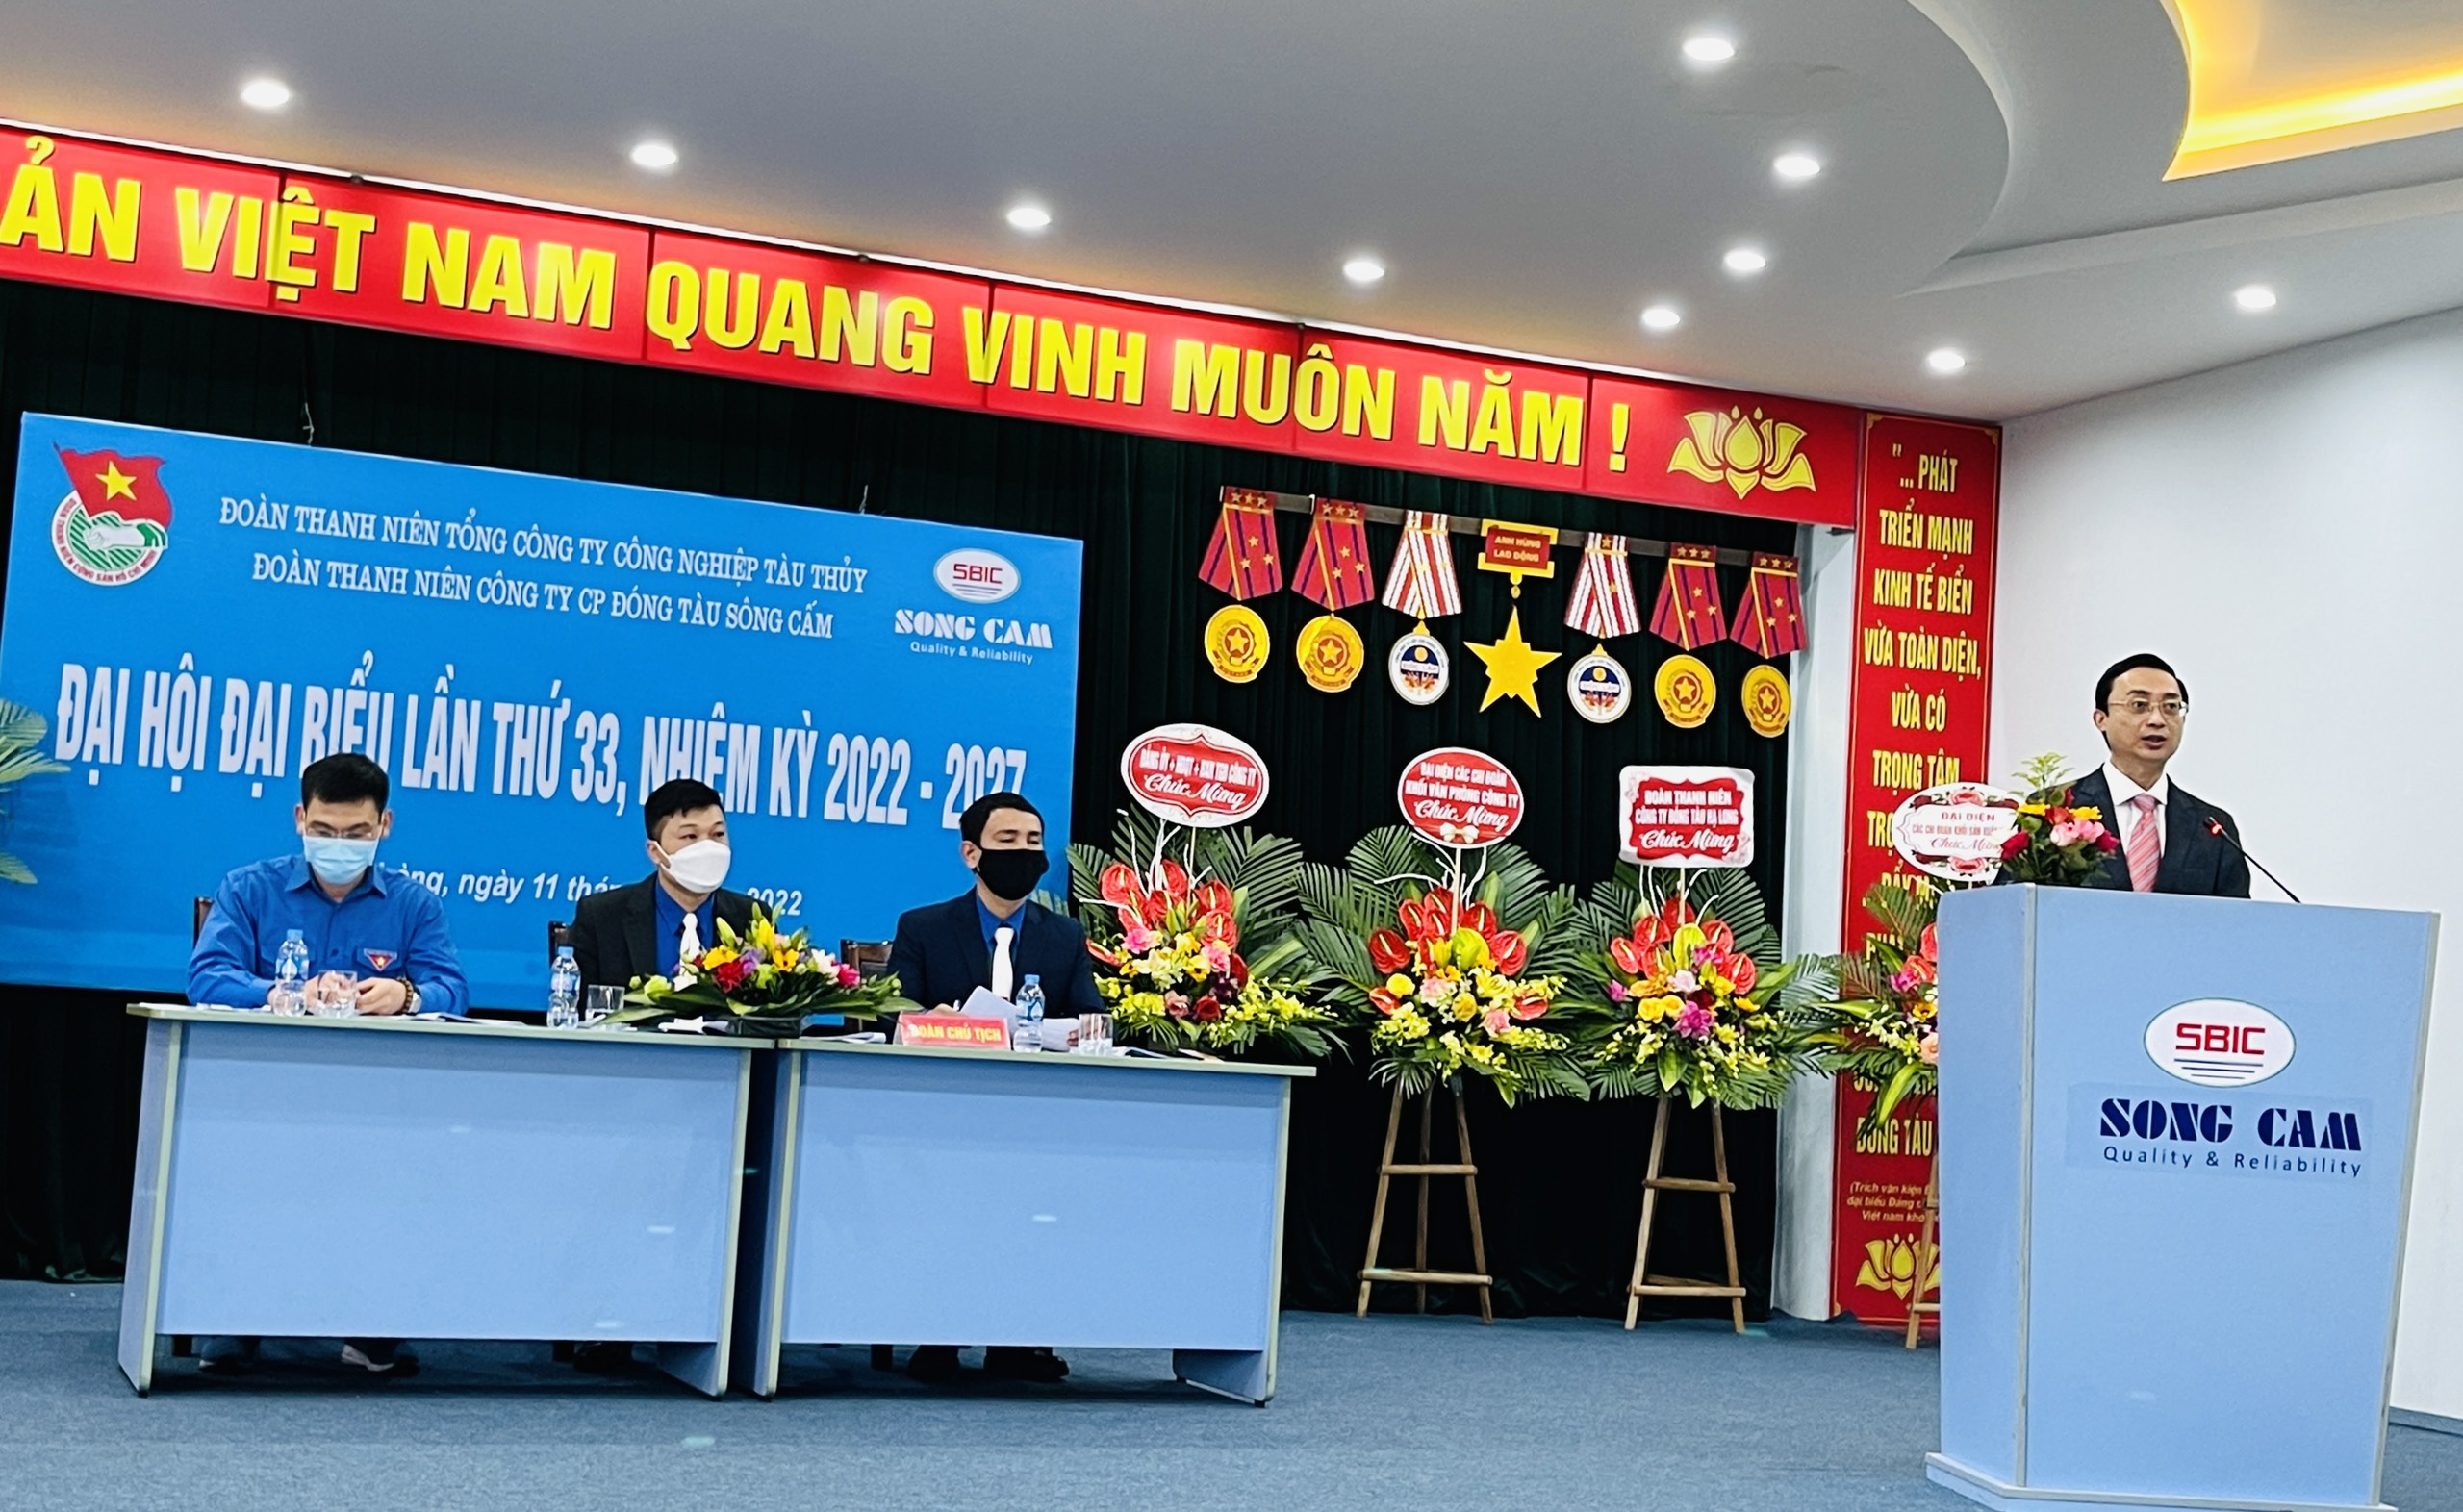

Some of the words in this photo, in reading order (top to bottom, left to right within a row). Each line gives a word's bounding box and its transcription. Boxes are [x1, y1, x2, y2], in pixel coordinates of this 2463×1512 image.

[0, 135, 142, 263] ẢN
[175, 187, 376, 302] VIỆT
[401, 221, 616, 329] NAM
[646, 260, 935, 376] QUANG
[962, 306, 1147, 406] VINH
[1171, 339, 1396, 440] MUÔN
[1417, 368, 1585, 467] NĂM
[1609, 404, 1630, 472] !
[1917, 449, 1959, 493] PHÁT
[219, 492, 290, 530] ĐOÀN
[294, 506, 377, 540] THANH
[381, 510, 441, 546] NIÊN
[445, 507, 508, 554] TỔNG
[513, 523, 574, 562] CÔNG
[579, 537, 609, 565] TY
[613, 535, 673, 573] CÔNG
[677, 547, 759, 588] NGHIỆP
[764, 552, 806, 588] TÀU
[810, 555, 868, 593] THỦY
[1879, 497, 1924, 549] TRIỂN
[1927, 515, 1974, 561] MẠNH
[252, 549, 321, 586] ĐOÀN
[327, 561, 409, 594] THANH
[413, 565, 472, 601] NIÊN
[476, 570, 539, 608] CÔNG
[544, 583, 574, 612] TY
[578, 587, 606, 614] CP
[610, 585, 673, 622] ĐÓNG
[677, 592, 722, 627] TÀU
[725, 596, 784, 633] SÔNG
[787, 600, 834, 638] CẤM
[953, 563, 1003, 585] SBIC
[1873, 567, 1912, 609] KINH
[1916, 561, 1936, 611] TẾ
[1937, 563, 1974, 616] BIỂN
[894, 608, 977, 642] SONG
[983, 618, 1054, 649] CAM
[910, 641, 956, 657] Quality
[959, 646, 968, 657] &
[971, 646, 1034, 666] Reliability
[1864, 619, 1894, 668] VỪA
[1898, 625, 1939, 671] TOÀN
[1942, 630, 1982, 683] DIỆN,
[1892, 683, 1921, 730] VỪA
[1925, 688, 1947, 733] CÓ
[55, 663, 131, 786] ĐẠI
[138, 652, 213, 793] HỘI
[219, 677, 292, 798] ĐẠI
[401, 664, 482, 793] LẦN
[493, 679, 571, 800] THỨ
[571, 710, 627, 817] 33,
[770, 710, 819, 819] KỲ
[824, 732, 911, 826] 2022
[919, 781, 933, 800] -
[1144, 773, 1191, 796] Chúc
[1189, 782, 1247, 810] Mừng
[1872, 749, 1923, 796] TRỌNG
[1927, 747, 1961, 789] TÂM
[1414, 799, 1459, 820] Chúc
[1459, 806, 1509, 832] Mừng
[1482, 789, 1507, 808] CÔNG
[1508, 794, 1519, 809] TY
[1674, 790, 1707, 806] THANH
[1708, 787, 1732, 806] NIÊN
[1639, 829, 1685, 850] Chúc
[1684, 829, 1735, 854] Mừng
[1866, 810, 1894, 857] TRỌ
[458, 869, 525, 904] ngày
[533, 873, 559, 900] 11
[947, 1021, 973, 1041] CHỦ
[973, 1027, 1002, 1044] TỊCH
[2175, 1022, 2266, 1056] SBIC
[1903, 1111, 1933, 1157] TÀU
[2099, 1097, 2234, 1144] SONG
[2257, 1108, 2362, 1152] CAM
[2103, 1146, 2193, 1169] Quality
[2205, 1150, 2220, 1167] &
[2234, 1153, 2362, 1177] Reliability
